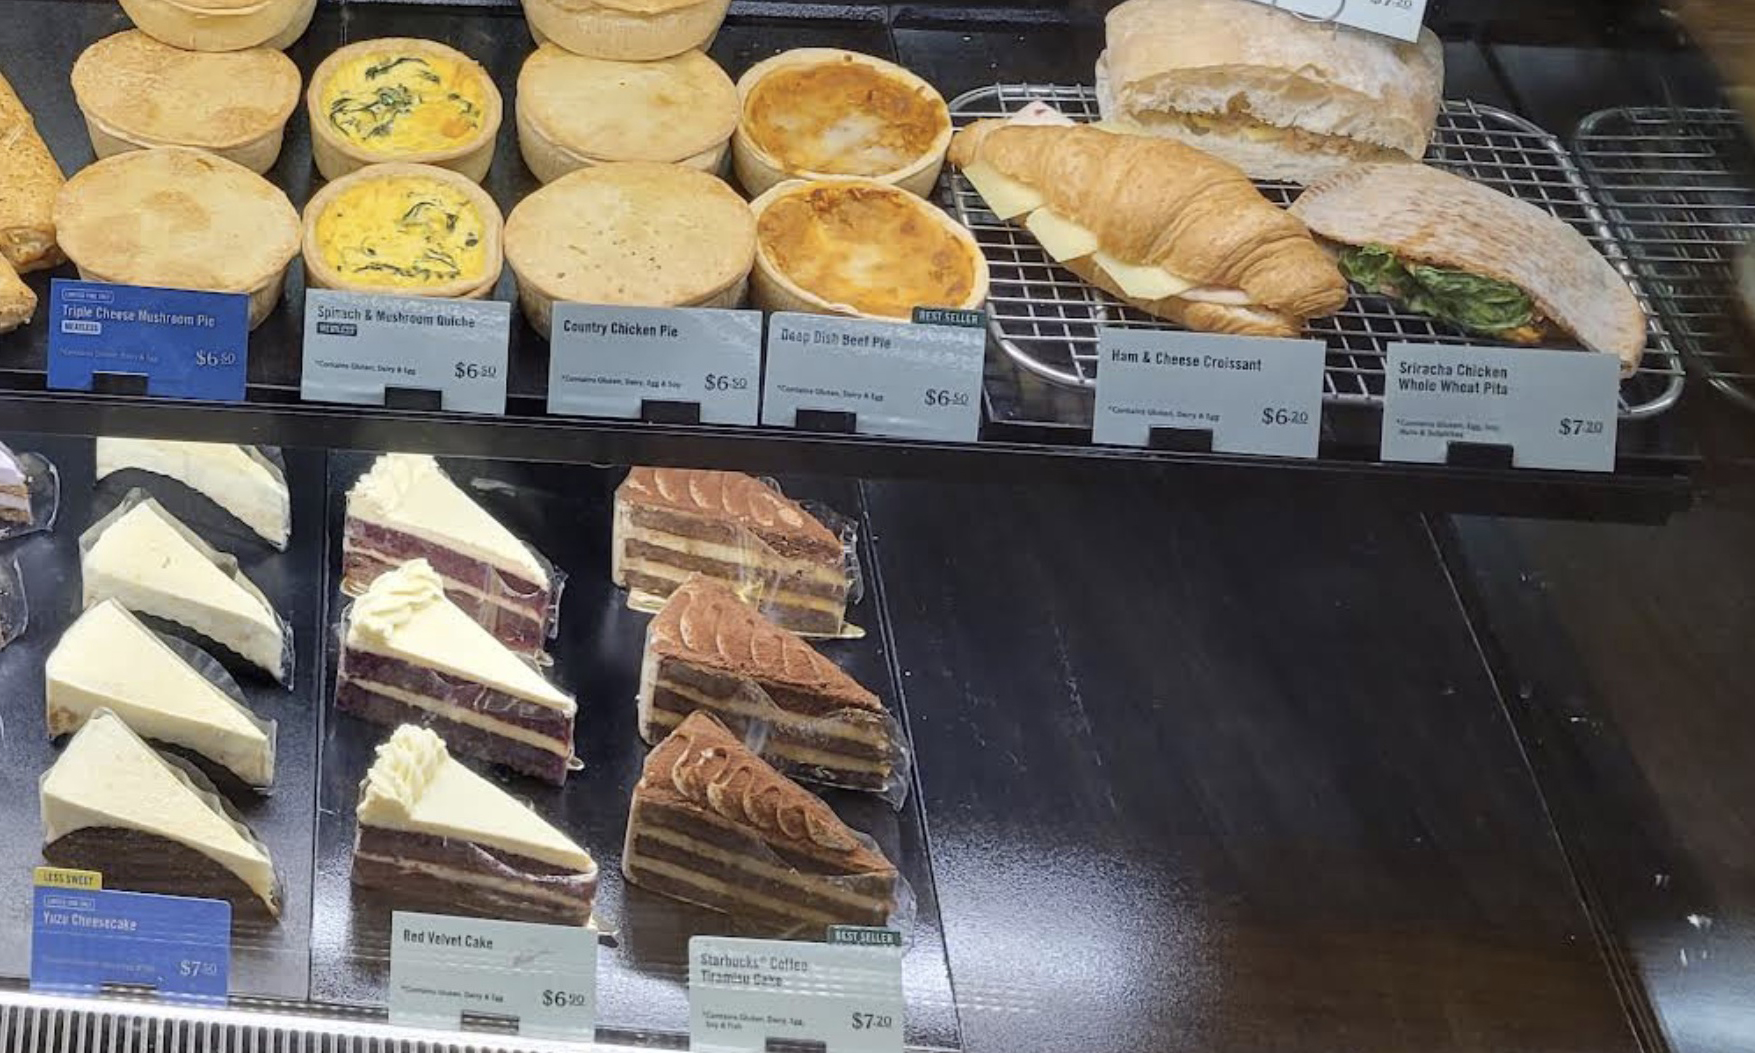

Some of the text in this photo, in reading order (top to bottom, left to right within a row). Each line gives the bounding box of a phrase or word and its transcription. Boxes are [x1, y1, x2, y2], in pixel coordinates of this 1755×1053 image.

[62, 303, 215, 327] Triple Cheese Mushroom Pie
[563, 319, 678, 338] Country Chicken Pie
[1111, 349, 1262, 373] Ham & Cheese Croissant
[1399, 360, 1508, 380] Sriracha Chicken
[704, 373, 748, 392] $6.50
[1398, 377, 1509, 396] Whole Wheat Pita
[1261, 407, 1309, 426] $6.20
[1559, 418, 1603, 437] $7.20
[43, 872, 94, 886] LESS SWEET
[43, 911, 137, 932] Yuzu Cheesecake
[403, 929, 493, 950] Red Velvet Cake
[835, 929, 894, 945] BEST SELLER
